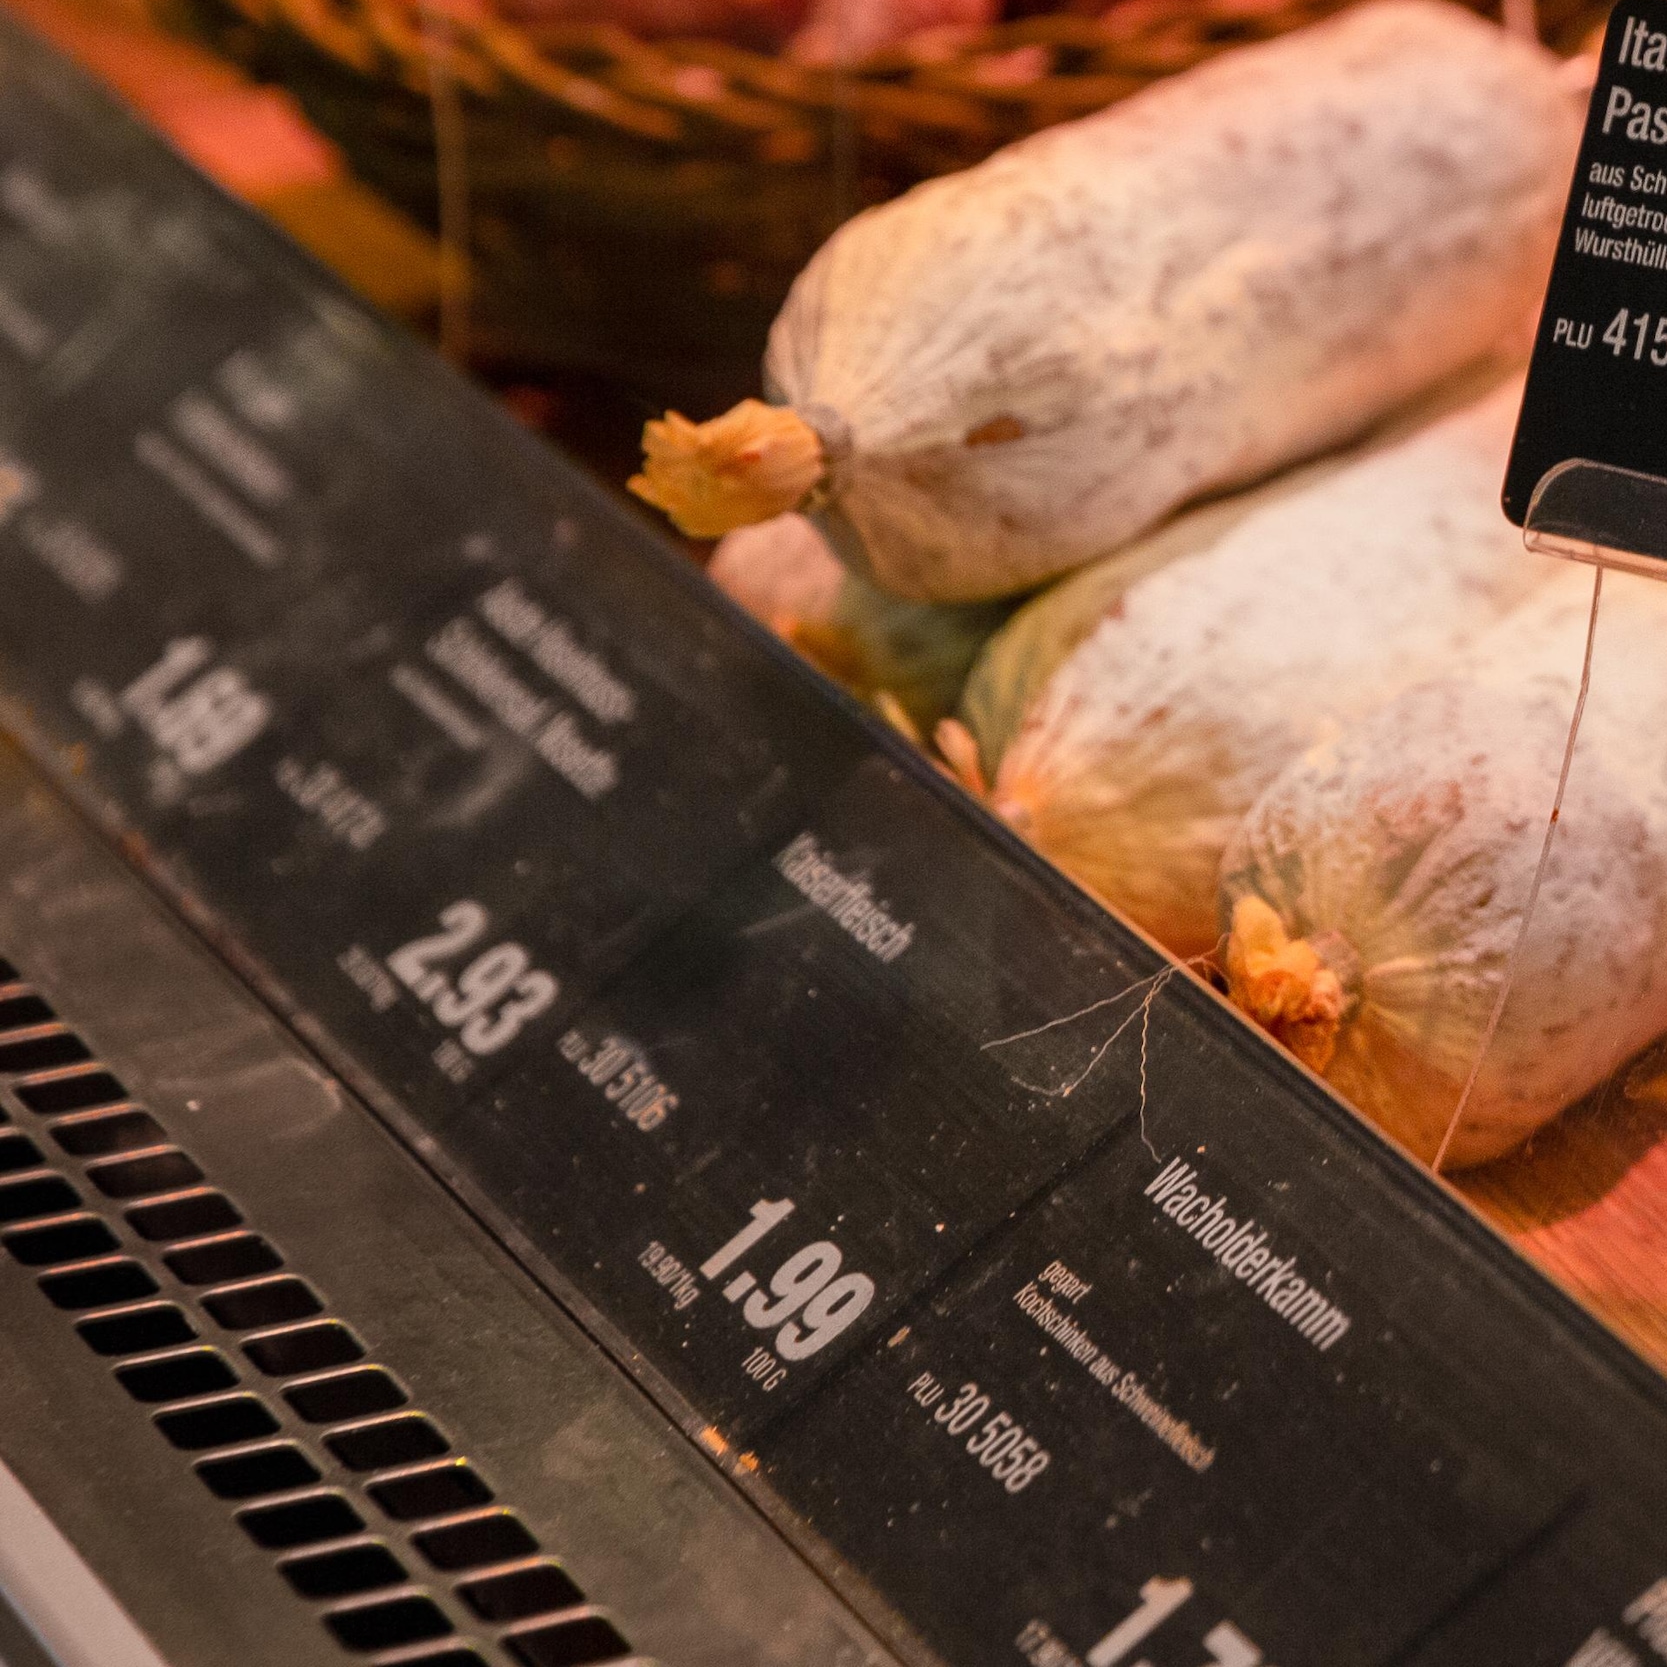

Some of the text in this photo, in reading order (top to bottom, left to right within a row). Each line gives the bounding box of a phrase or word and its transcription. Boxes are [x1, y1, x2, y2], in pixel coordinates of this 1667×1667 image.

[1588, 162, 1626, 191] aus
[1552, 317, 1593, 352] PLU
[387, 898, 560, 1058] 2.93
[635, 1239, 783, 1393] 19.90/1kg 100 G
[698, 1195, 876, 1363] 1.99
[1037, 1257, 1094, 1306] gegart
[1143, 1156, 1352, 1352] Wacholderkamm
[1012, 1282, 1101, 1371] Kochschinken
[1088, 1351, 1119, 1388] aus
[906, 1370, 1053, 1496] PLU 30 5058
